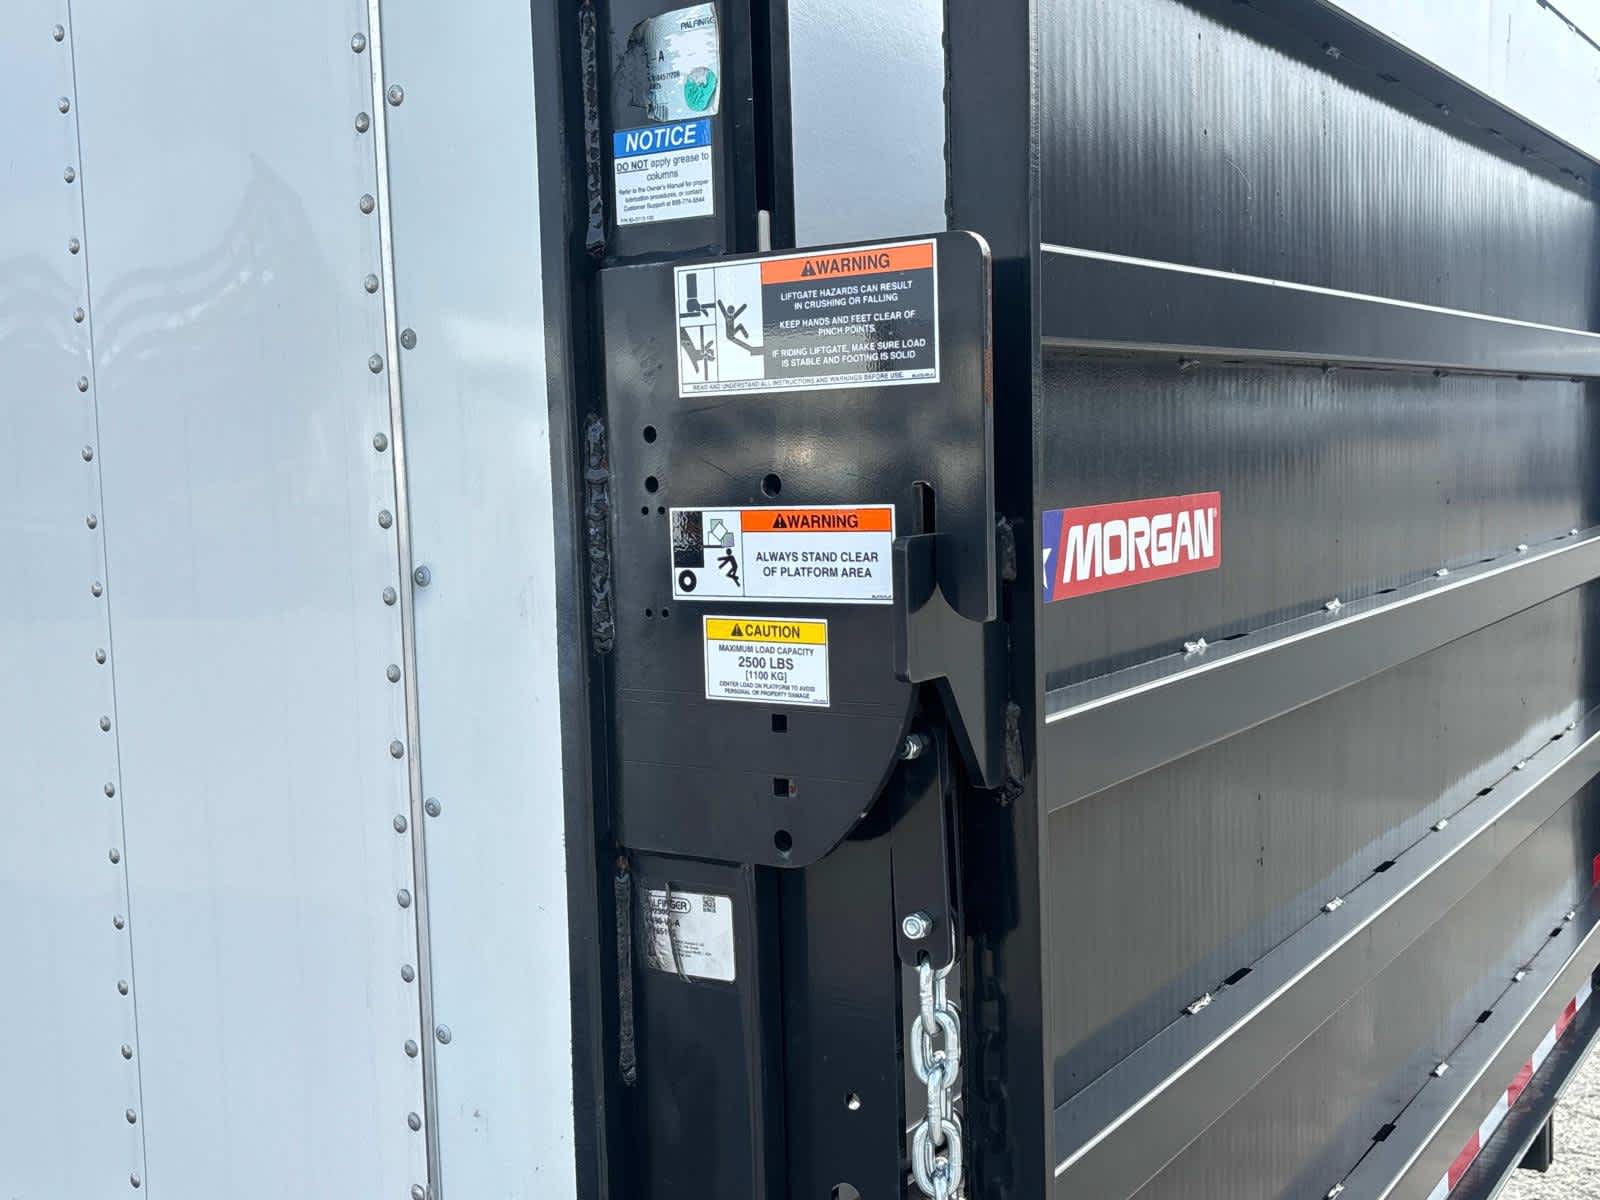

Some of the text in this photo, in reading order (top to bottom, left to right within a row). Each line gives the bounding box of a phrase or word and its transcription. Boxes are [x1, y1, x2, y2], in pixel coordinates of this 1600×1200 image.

[626, 124, 696, 152] NOTICE
[616, 152, 709, 171] DO NOT apply grease to
[647, 171, 678, 181] columns
[816, 254, 890, 274] WARNING
[781, 280, 912, 301] LIFTGATE HAZARDS CAN RESULT
[794, 293, 898, 310] IN CRUSHING OR FALLING
[780, 310, 916, 329] KEEP HANDS AND FEET CLEAR OF
[818, 327, 843, 336] PINCH
[781, 348, 807, 357] RIDING
[851, 343, 875, 352] MAKE
[877, 341, 899, 350] SURE
[902, 339, 926, 348] LOAD
[791, 358, 822, 367] STABLE
[823, 356, 840, 365] AND
[841, 353, 878, 363] FOOTING
[890, 350, 916, 359] SOLID
[787, 514, 858, 528] WARNING
[1062, 508, 1214, 584] MORGAN
[756, 551, 878, 562] ALWAYS STAND CLEAR
[763, 566, 872, 578] OF PLATFORM AREA
[745, 624, 800, 638] CAUTION
[719, 644, 814, 656] MAXIMUM LOAD CAPACITY
[738, 656, 794, 670] 2500 LBS
[746, 670, 787, 683] [1100 KG]
